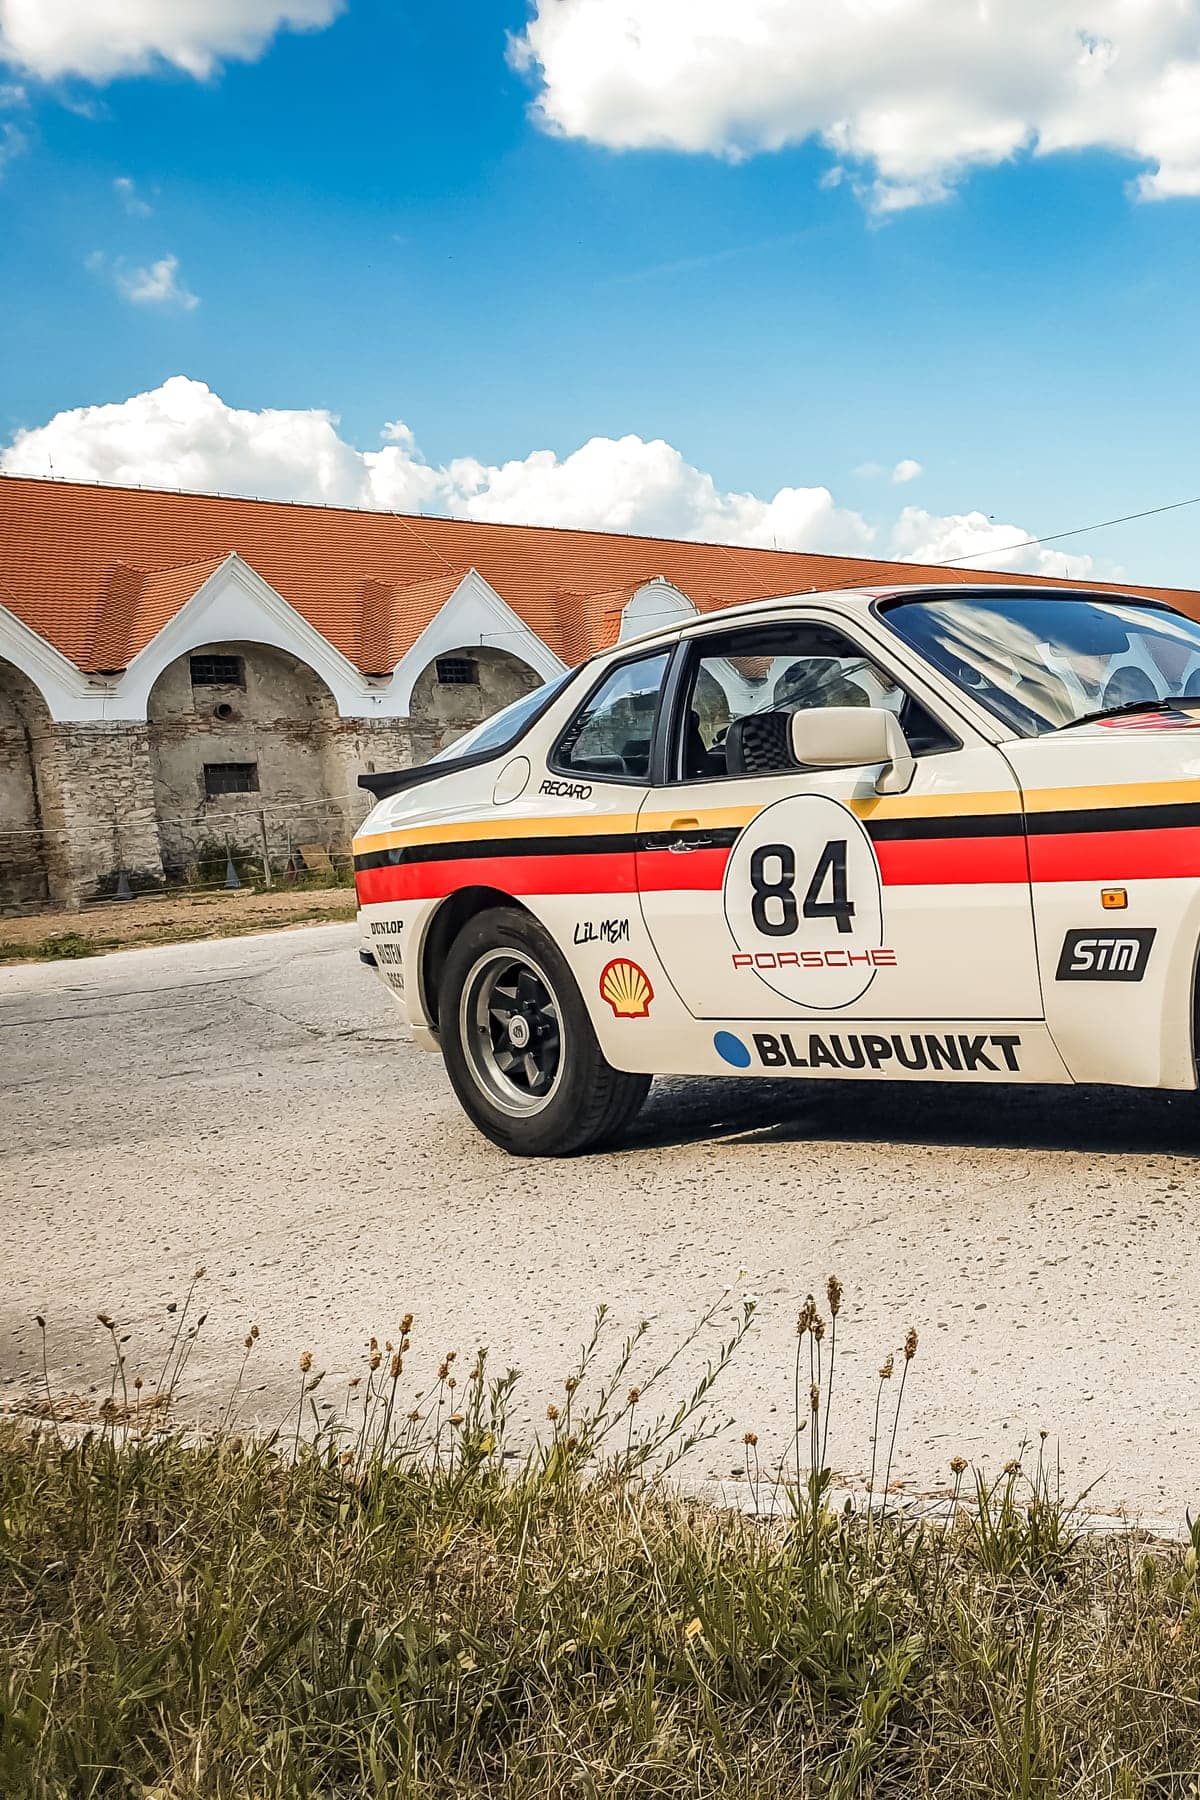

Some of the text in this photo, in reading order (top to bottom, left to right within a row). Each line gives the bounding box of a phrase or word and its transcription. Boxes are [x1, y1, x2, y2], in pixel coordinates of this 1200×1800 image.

[538, 779, 593, 800] RECARO
[749, 839, 856, 937] 84
[370, 920, 404, 935] DUNLOP
[731, 949, 898, 970] PORSCHE
[1070, 939, 1140, 971] STM
[751, 1033, 1022, 1072] BLAUPUNKT
